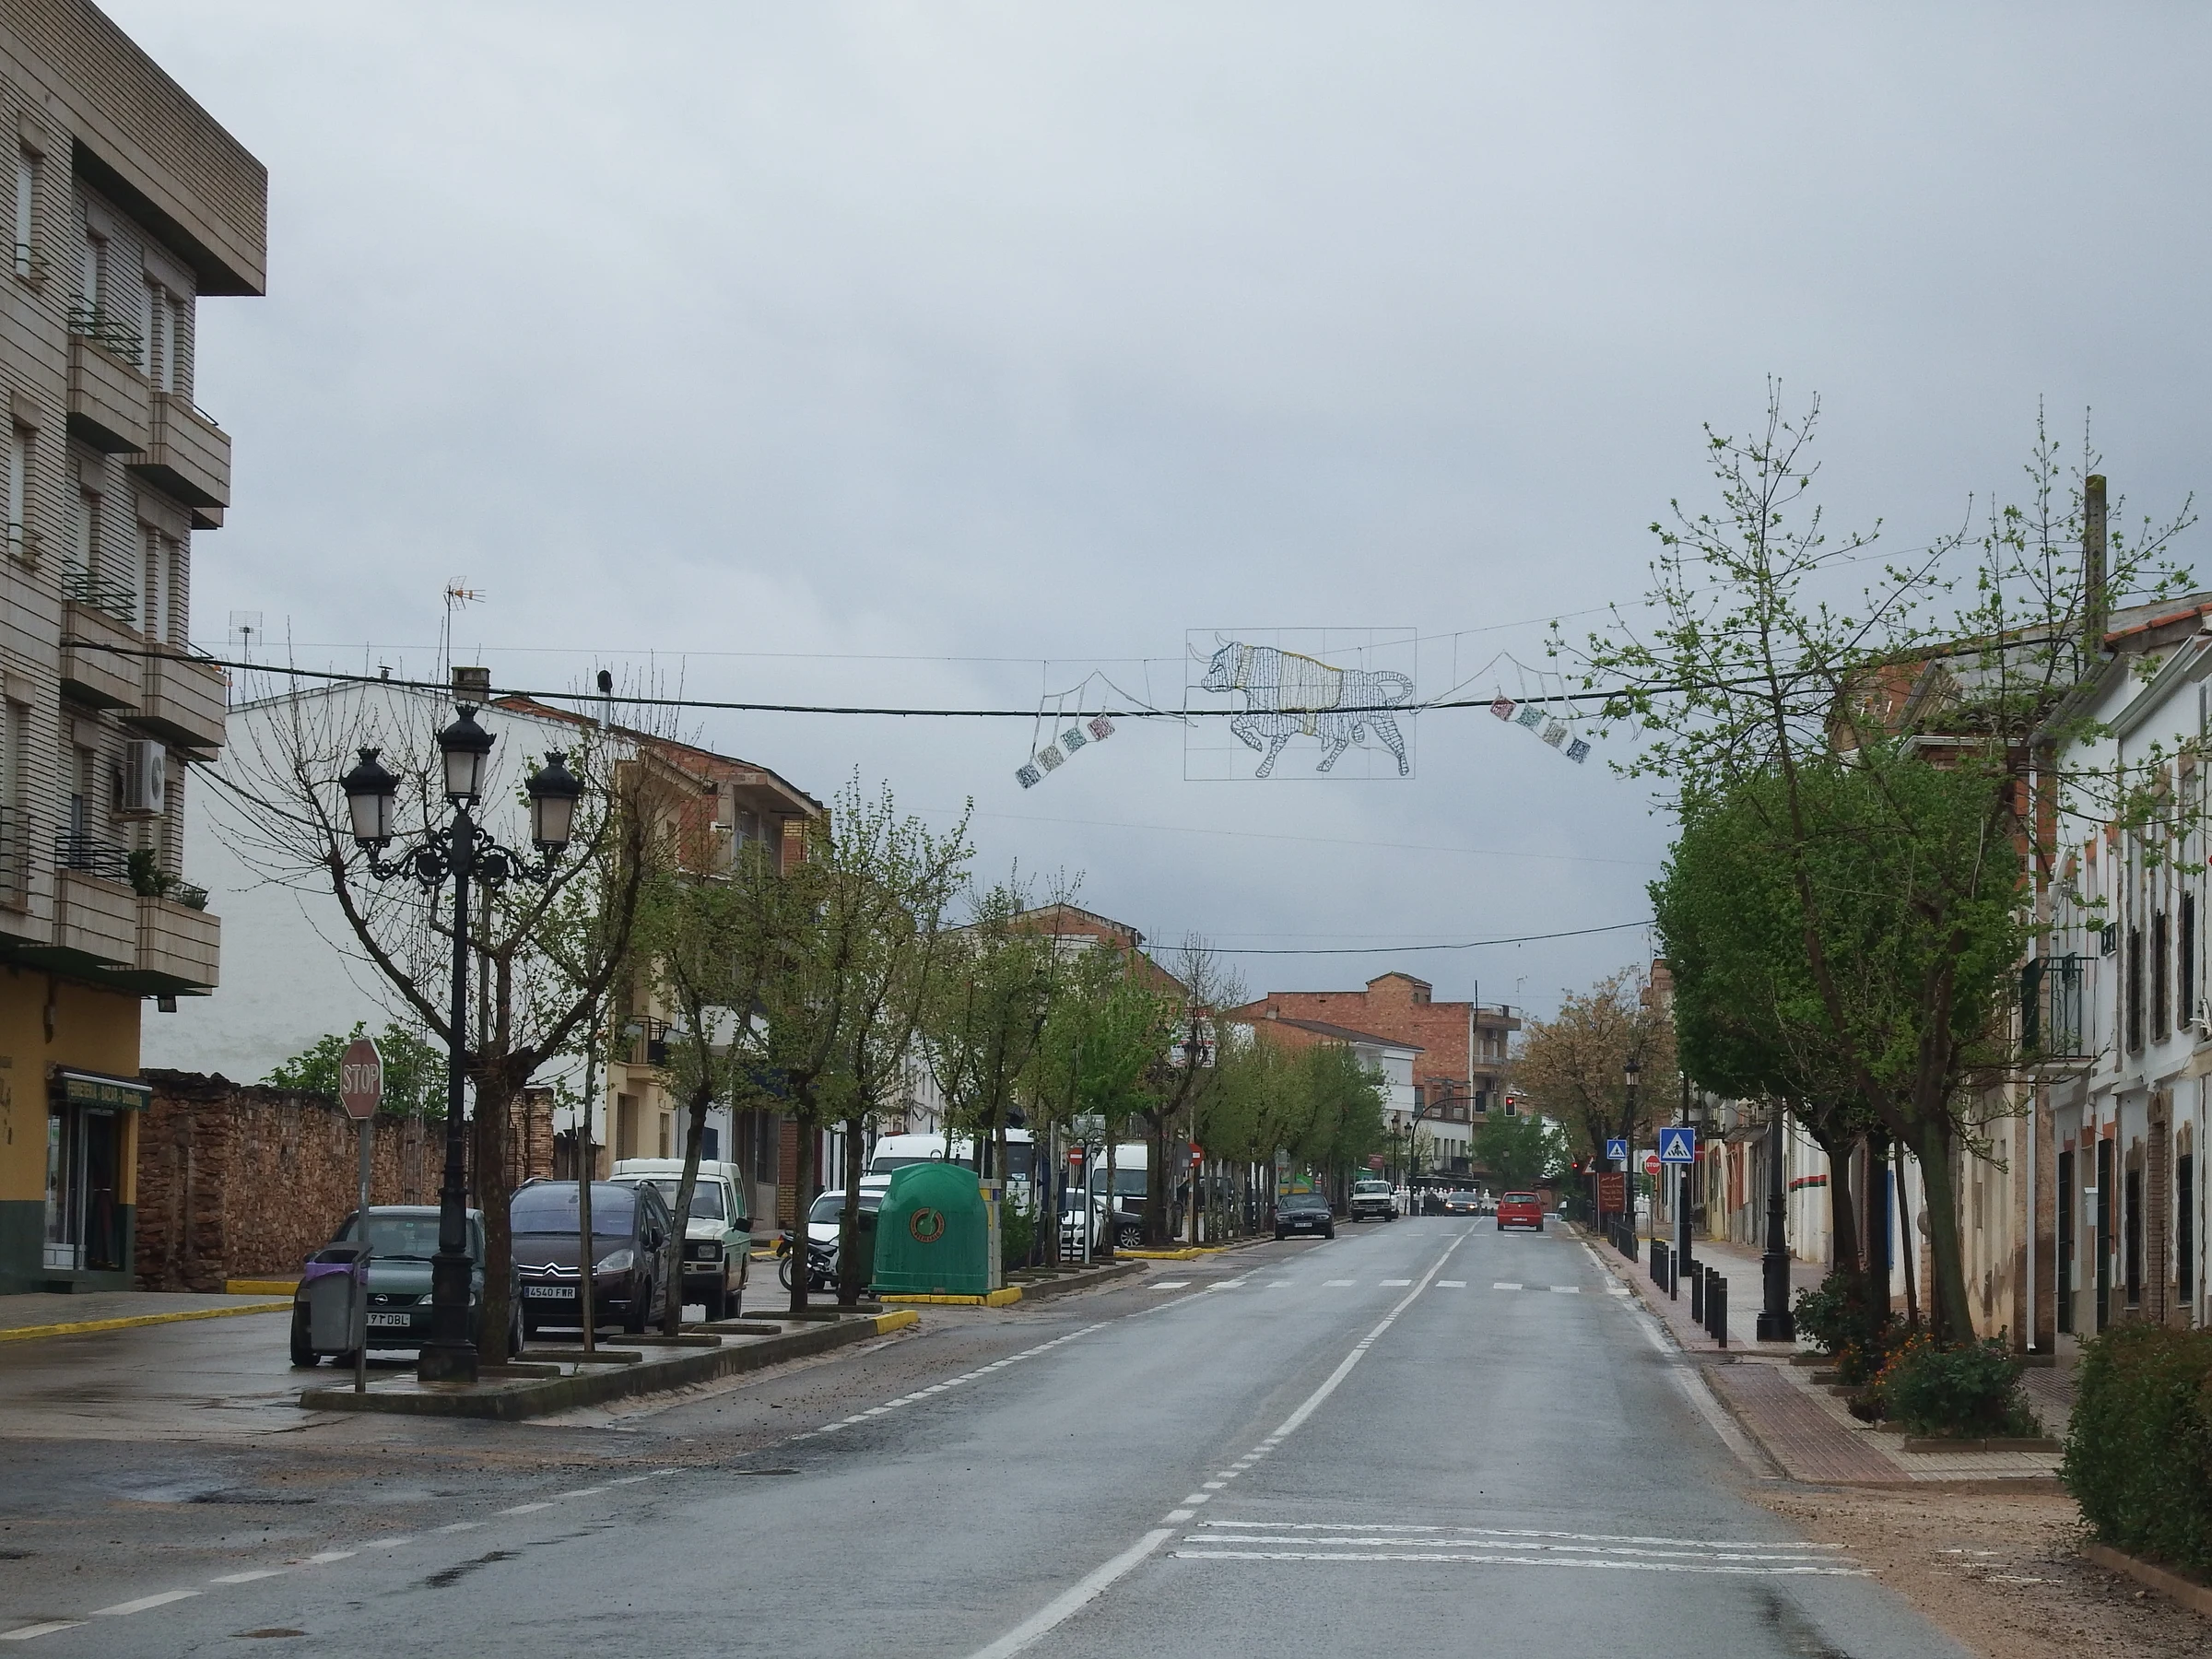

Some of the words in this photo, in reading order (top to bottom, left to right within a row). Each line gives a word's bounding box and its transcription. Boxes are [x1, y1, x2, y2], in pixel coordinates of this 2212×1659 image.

[342, 1064, 380, 1095] STOP
[531, 1288, 553, 1297] 4540
[556, 1288, 573, 1297] FWR
[387, 1315, 408, 1325] DBL
